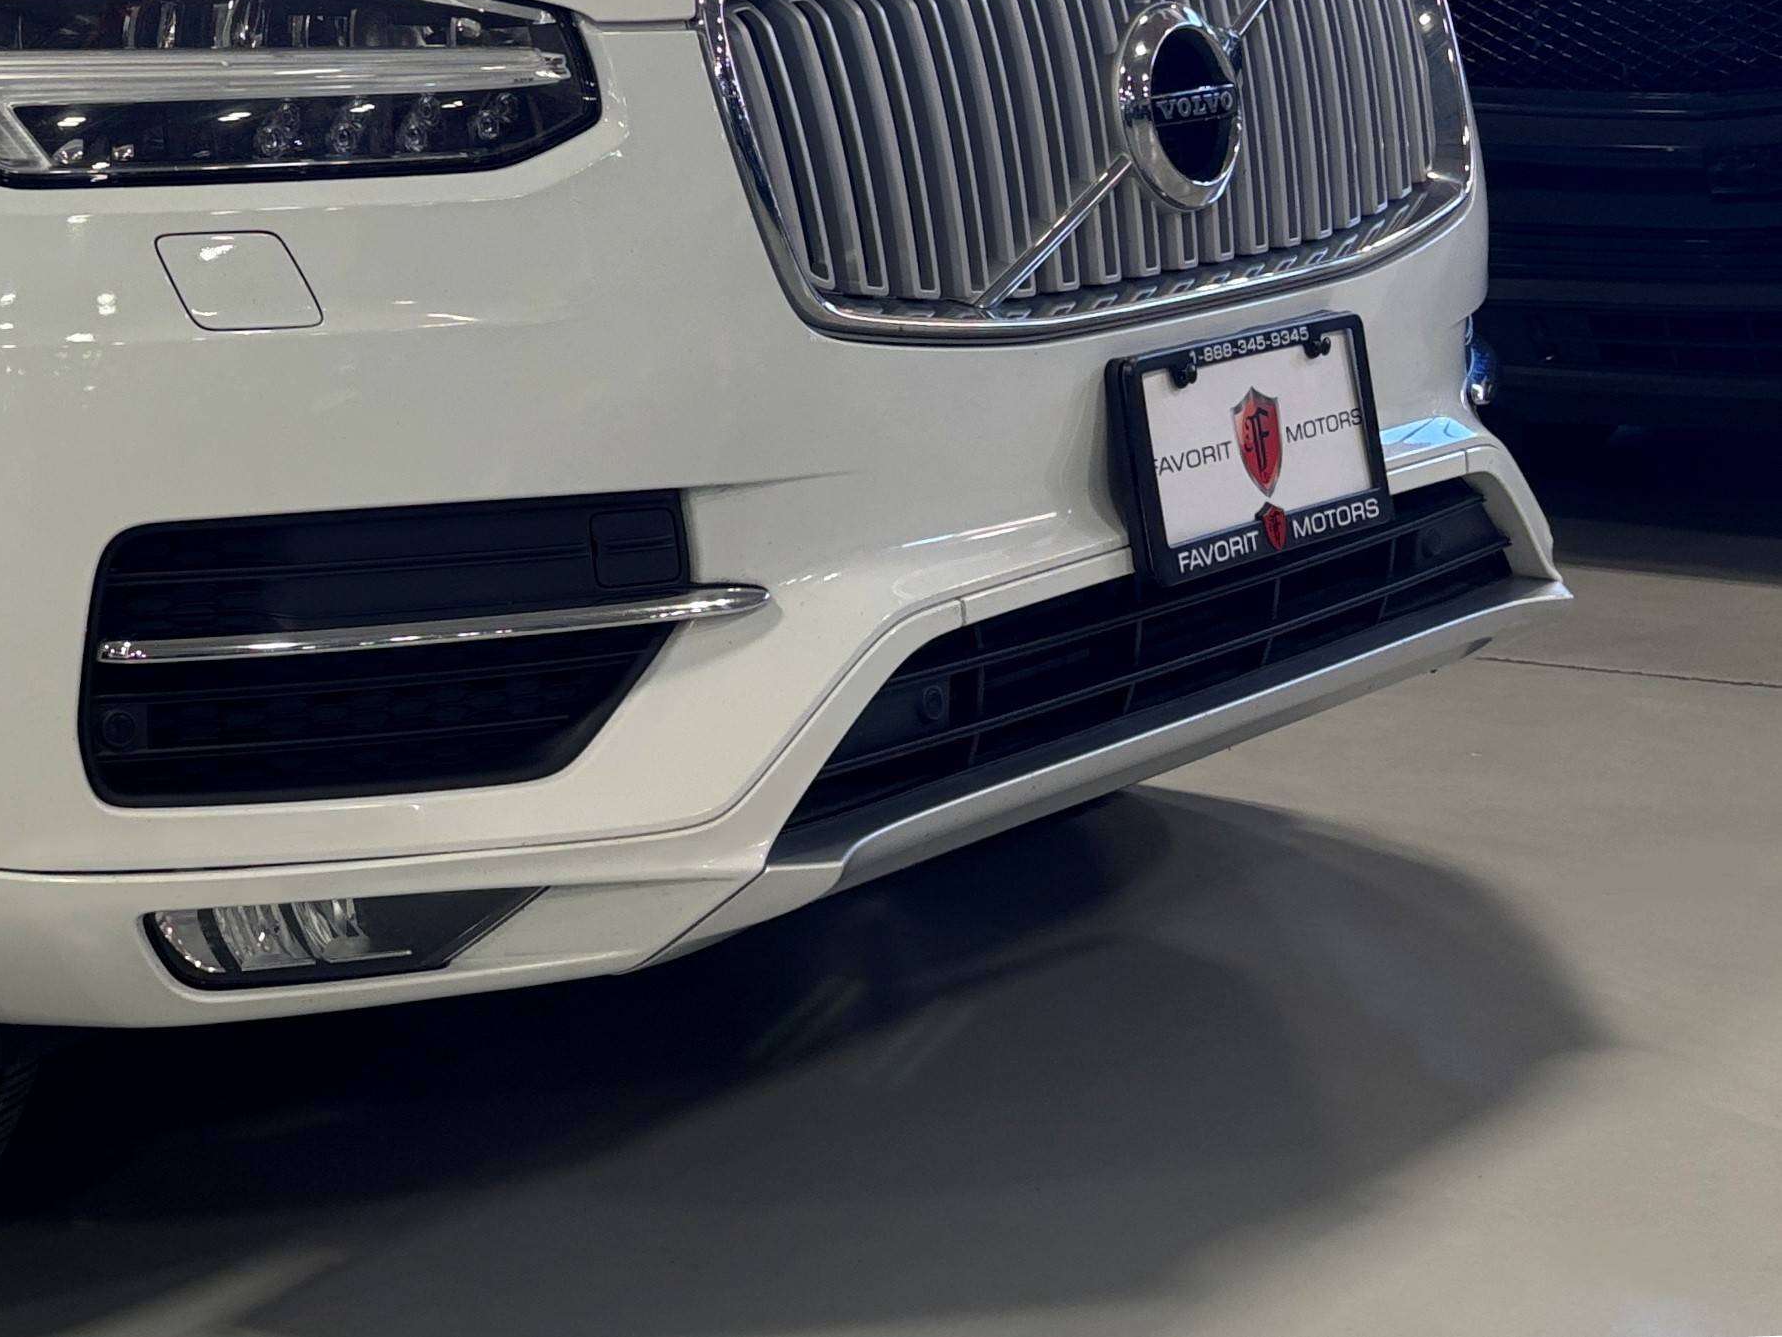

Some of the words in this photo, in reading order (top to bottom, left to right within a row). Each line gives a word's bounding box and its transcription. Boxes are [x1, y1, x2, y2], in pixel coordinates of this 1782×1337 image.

[1156, 90, 1234, 120] VOLVO
[1189, 326, 1310, 364] 1-888-345-9345
[1285, 407, 1363, 443] MOTORS
[1178, 531, 1259, 573] FAVORIT
[1292, 498, 1380, 539] MOTORS
